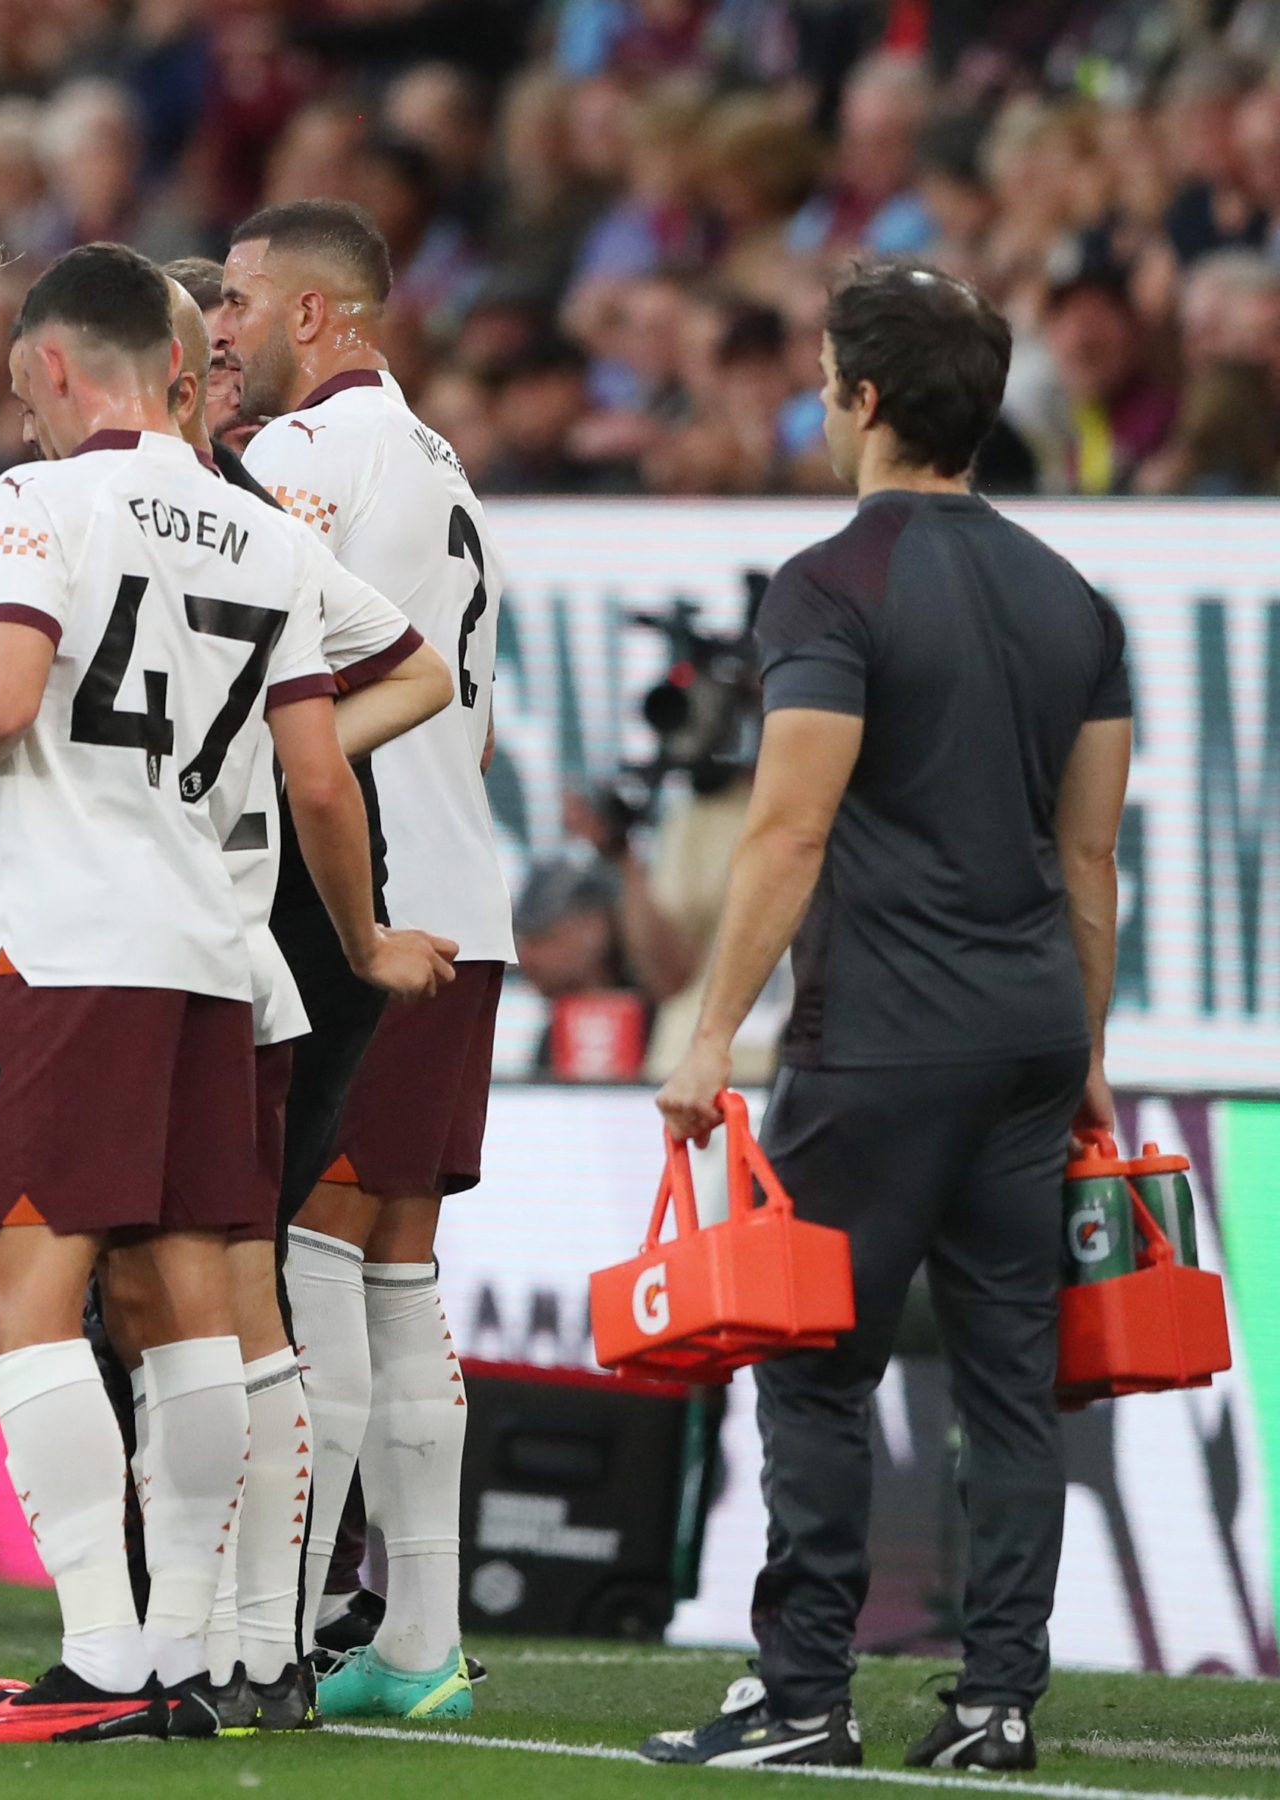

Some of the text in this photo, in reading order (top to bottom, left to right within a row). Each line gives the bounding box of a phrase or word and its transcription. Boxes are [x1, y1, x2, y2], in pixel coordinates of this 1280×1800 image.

[128, 497, 250, 565] FODEN
[447, 504, 487, 710] 2
[70, 574, 289, 804] 47
[1069, 1206, 1111, 1264] G
[632, 1261, 670, 1336] G
